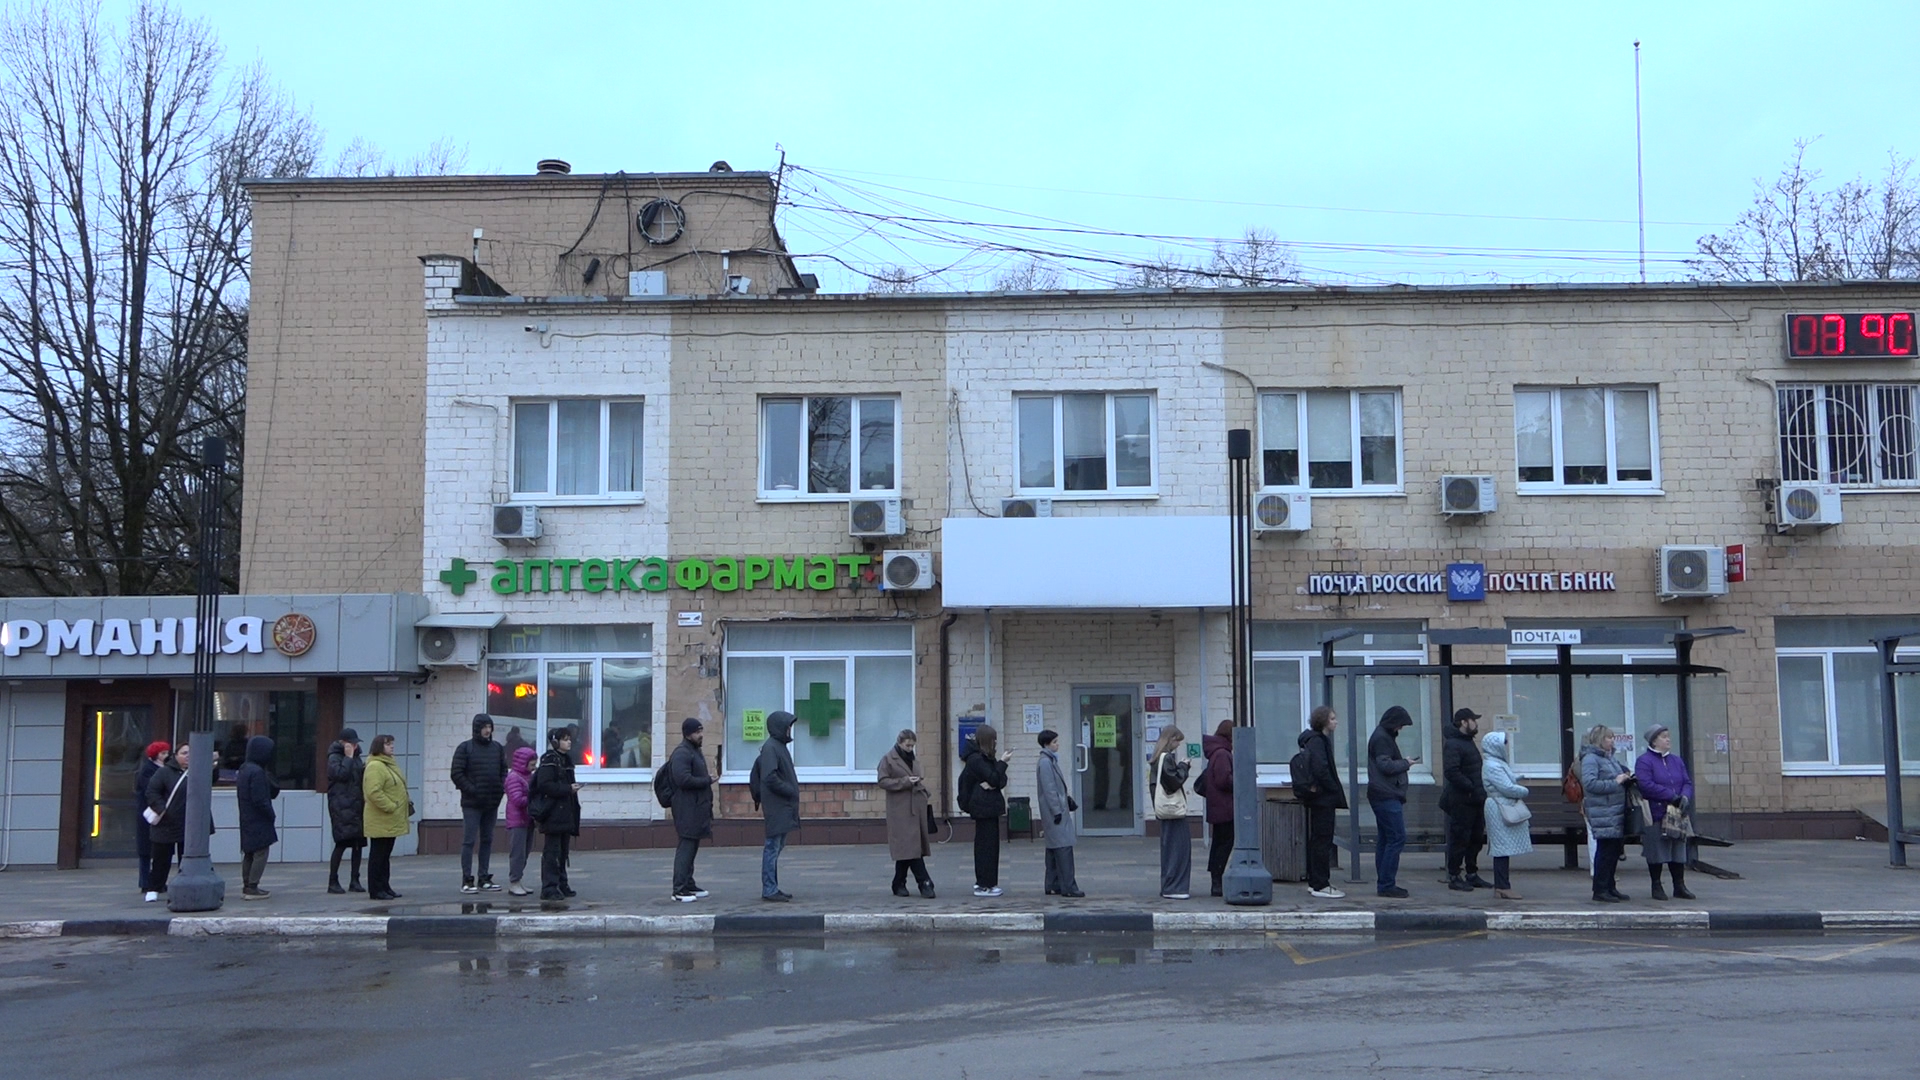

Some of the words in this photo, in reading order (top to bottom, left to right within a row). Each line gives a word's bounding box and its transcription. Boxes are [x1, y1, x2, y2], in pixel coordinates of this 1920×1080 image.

[490, 556, 668, 595] аптека
[1309, 575, 1367, 594] ПОЧТА
[1371, 573, 1442, 593] РОССИИ
[1488, 572, 1553, 591] ПОЧТА
[1560, 572, 1616, 591] БАНК
[1514, 631, 1561, 642] ПОЧТА
